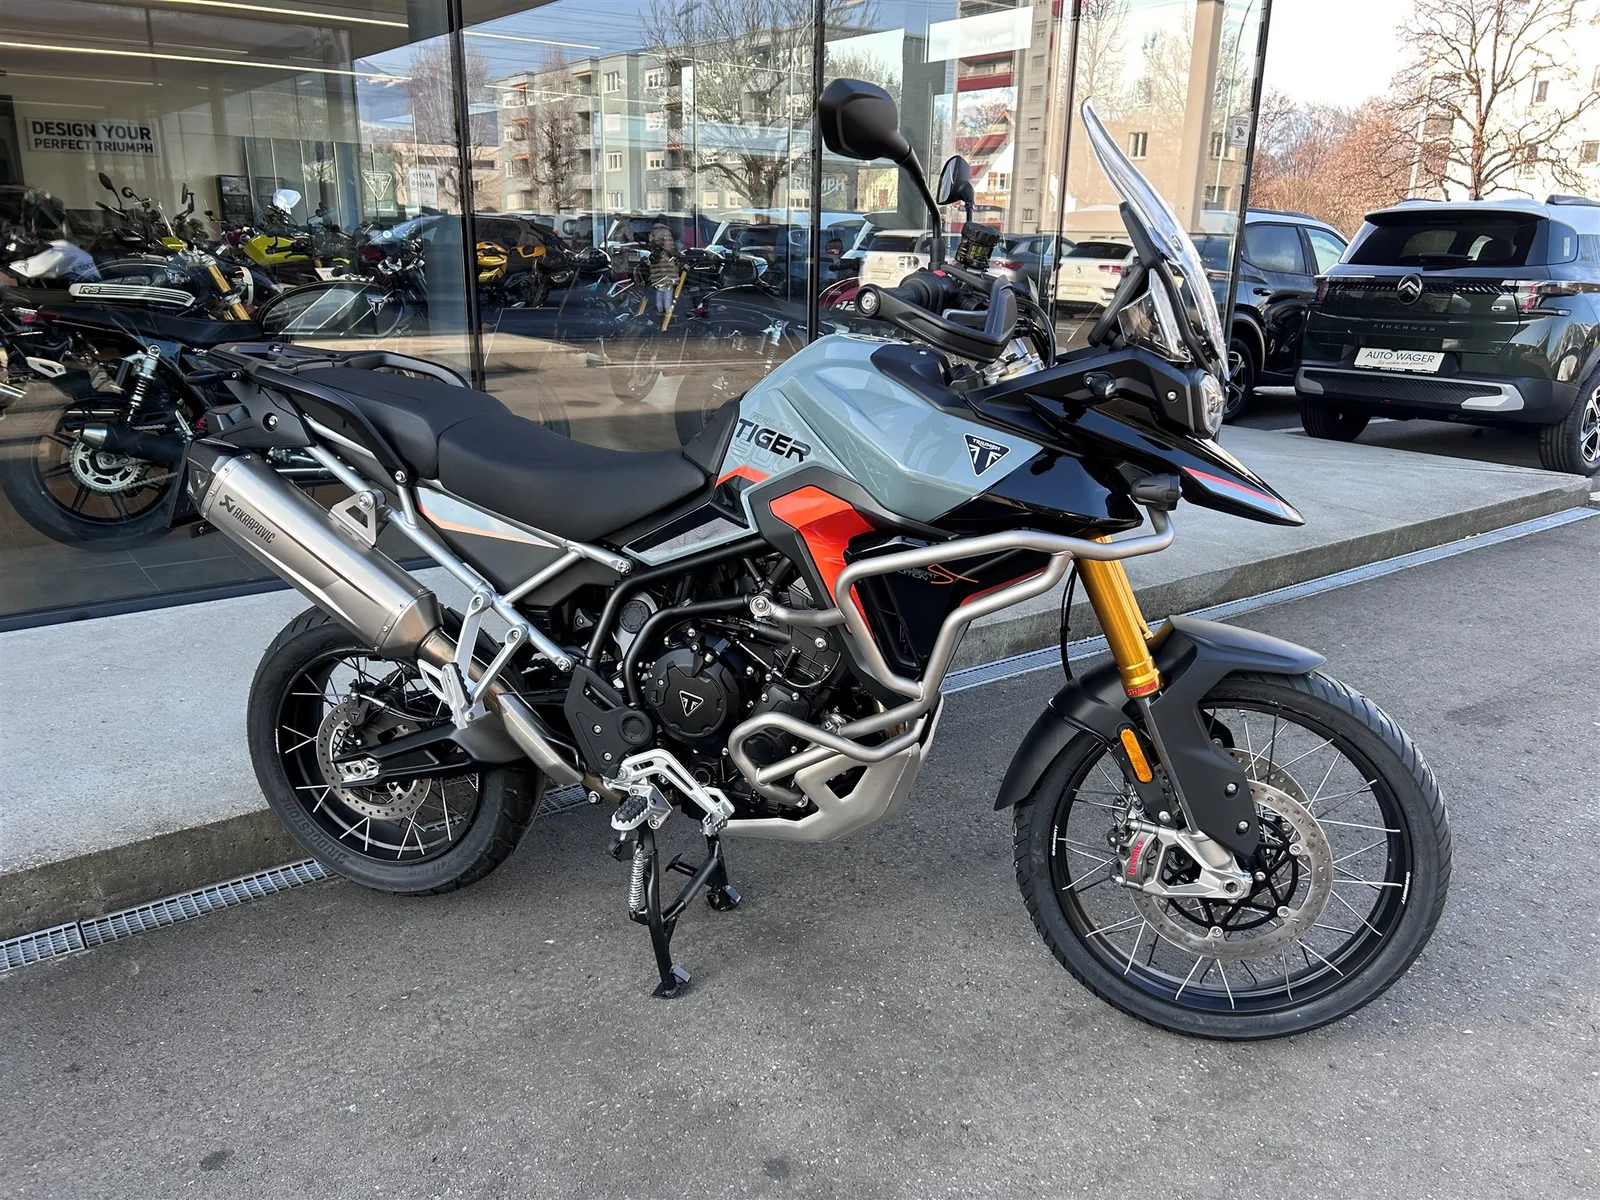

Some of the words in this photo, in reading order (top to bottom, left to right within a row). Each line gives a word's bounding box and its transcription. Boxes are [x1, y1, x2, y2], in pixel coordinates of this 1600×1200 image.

[32, 120, 97, 138] DESIGN
[102, 125, 151, 140] YOUR
[34, 138, 91, 150] PERFECT
[95, 140, 154, 153] TRIUMPH
[80, 286, 100, 294] RS
[1365, 350, 1393, 360] AUTO
[750, 411, 798, 435] RALLY
[735, 418, 811, 463] TIGER
[972, 438, 1001, 451] TRIUMPH
[279, 794, 351, 864] BRIDGESTONE
[1127, 840, 1144, 875] brembo
